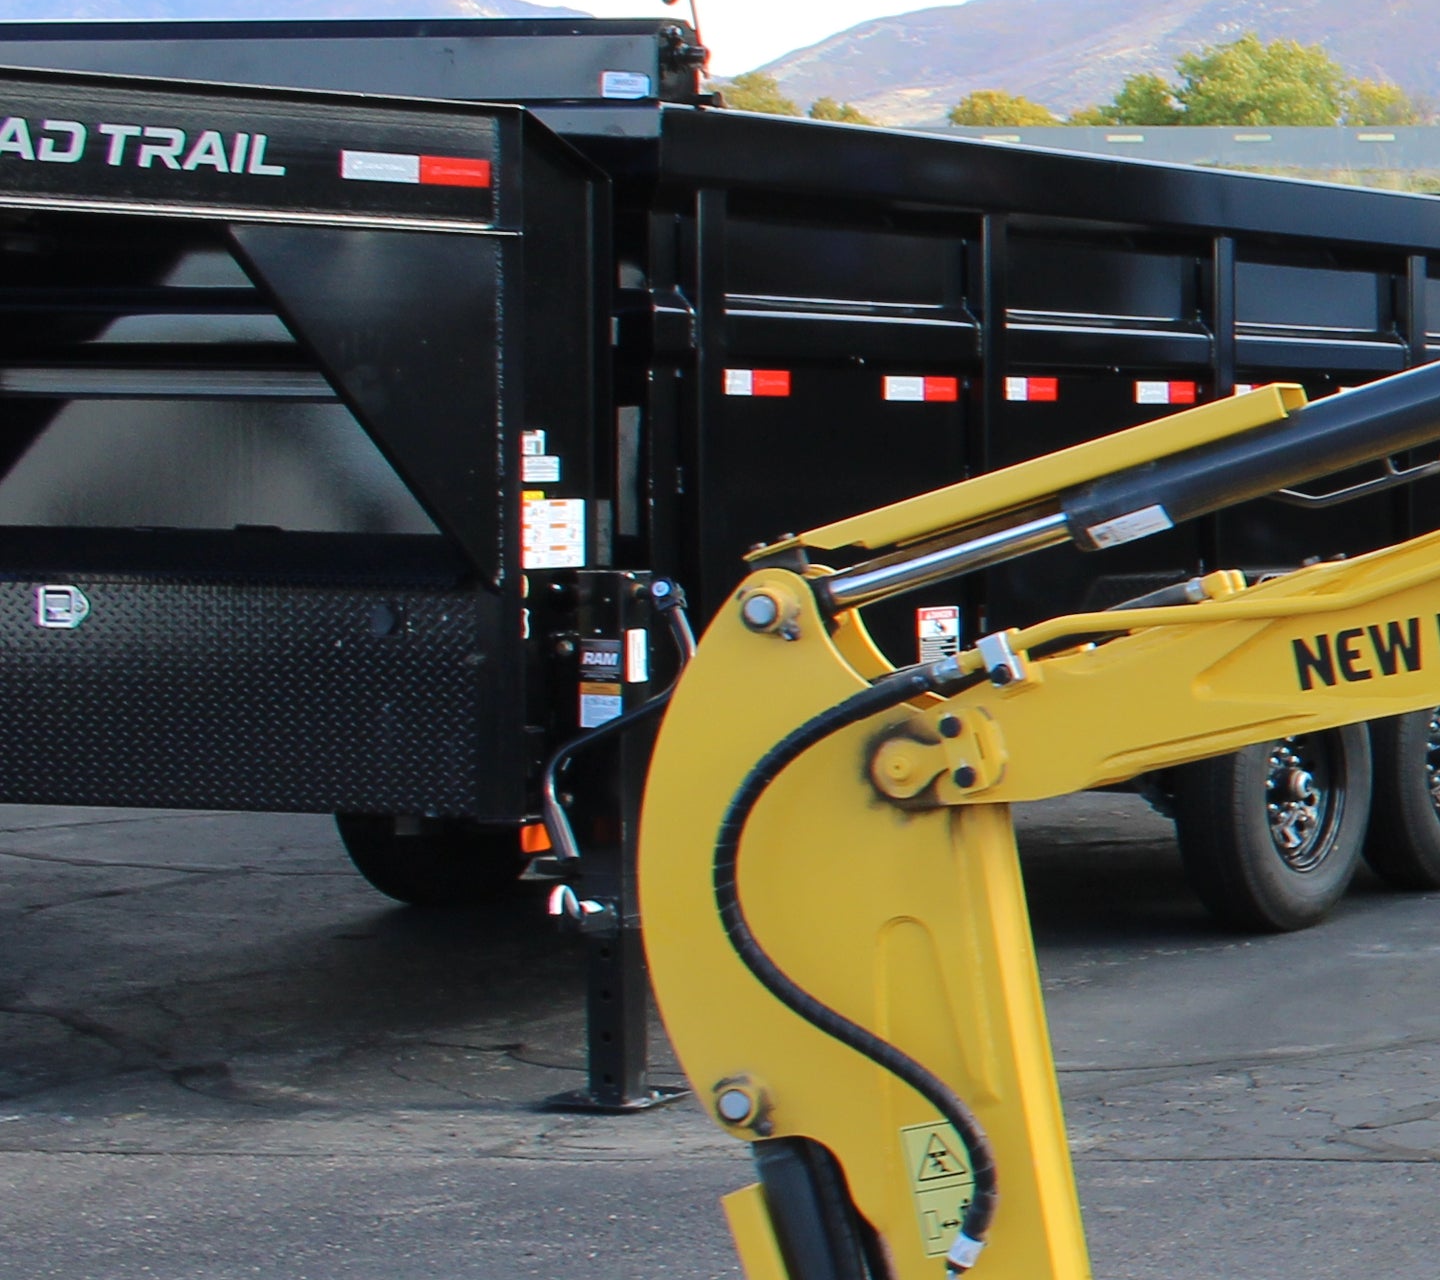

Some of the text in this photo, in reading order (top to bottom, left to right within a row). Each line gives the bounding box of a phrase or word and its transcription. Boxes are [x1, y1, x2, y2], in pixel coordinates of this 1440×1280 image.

[99, 123, 286, 176] TRAIL
[582, 651, 619, 666] RAM
[1292, 617, 1421, 692] NEW
